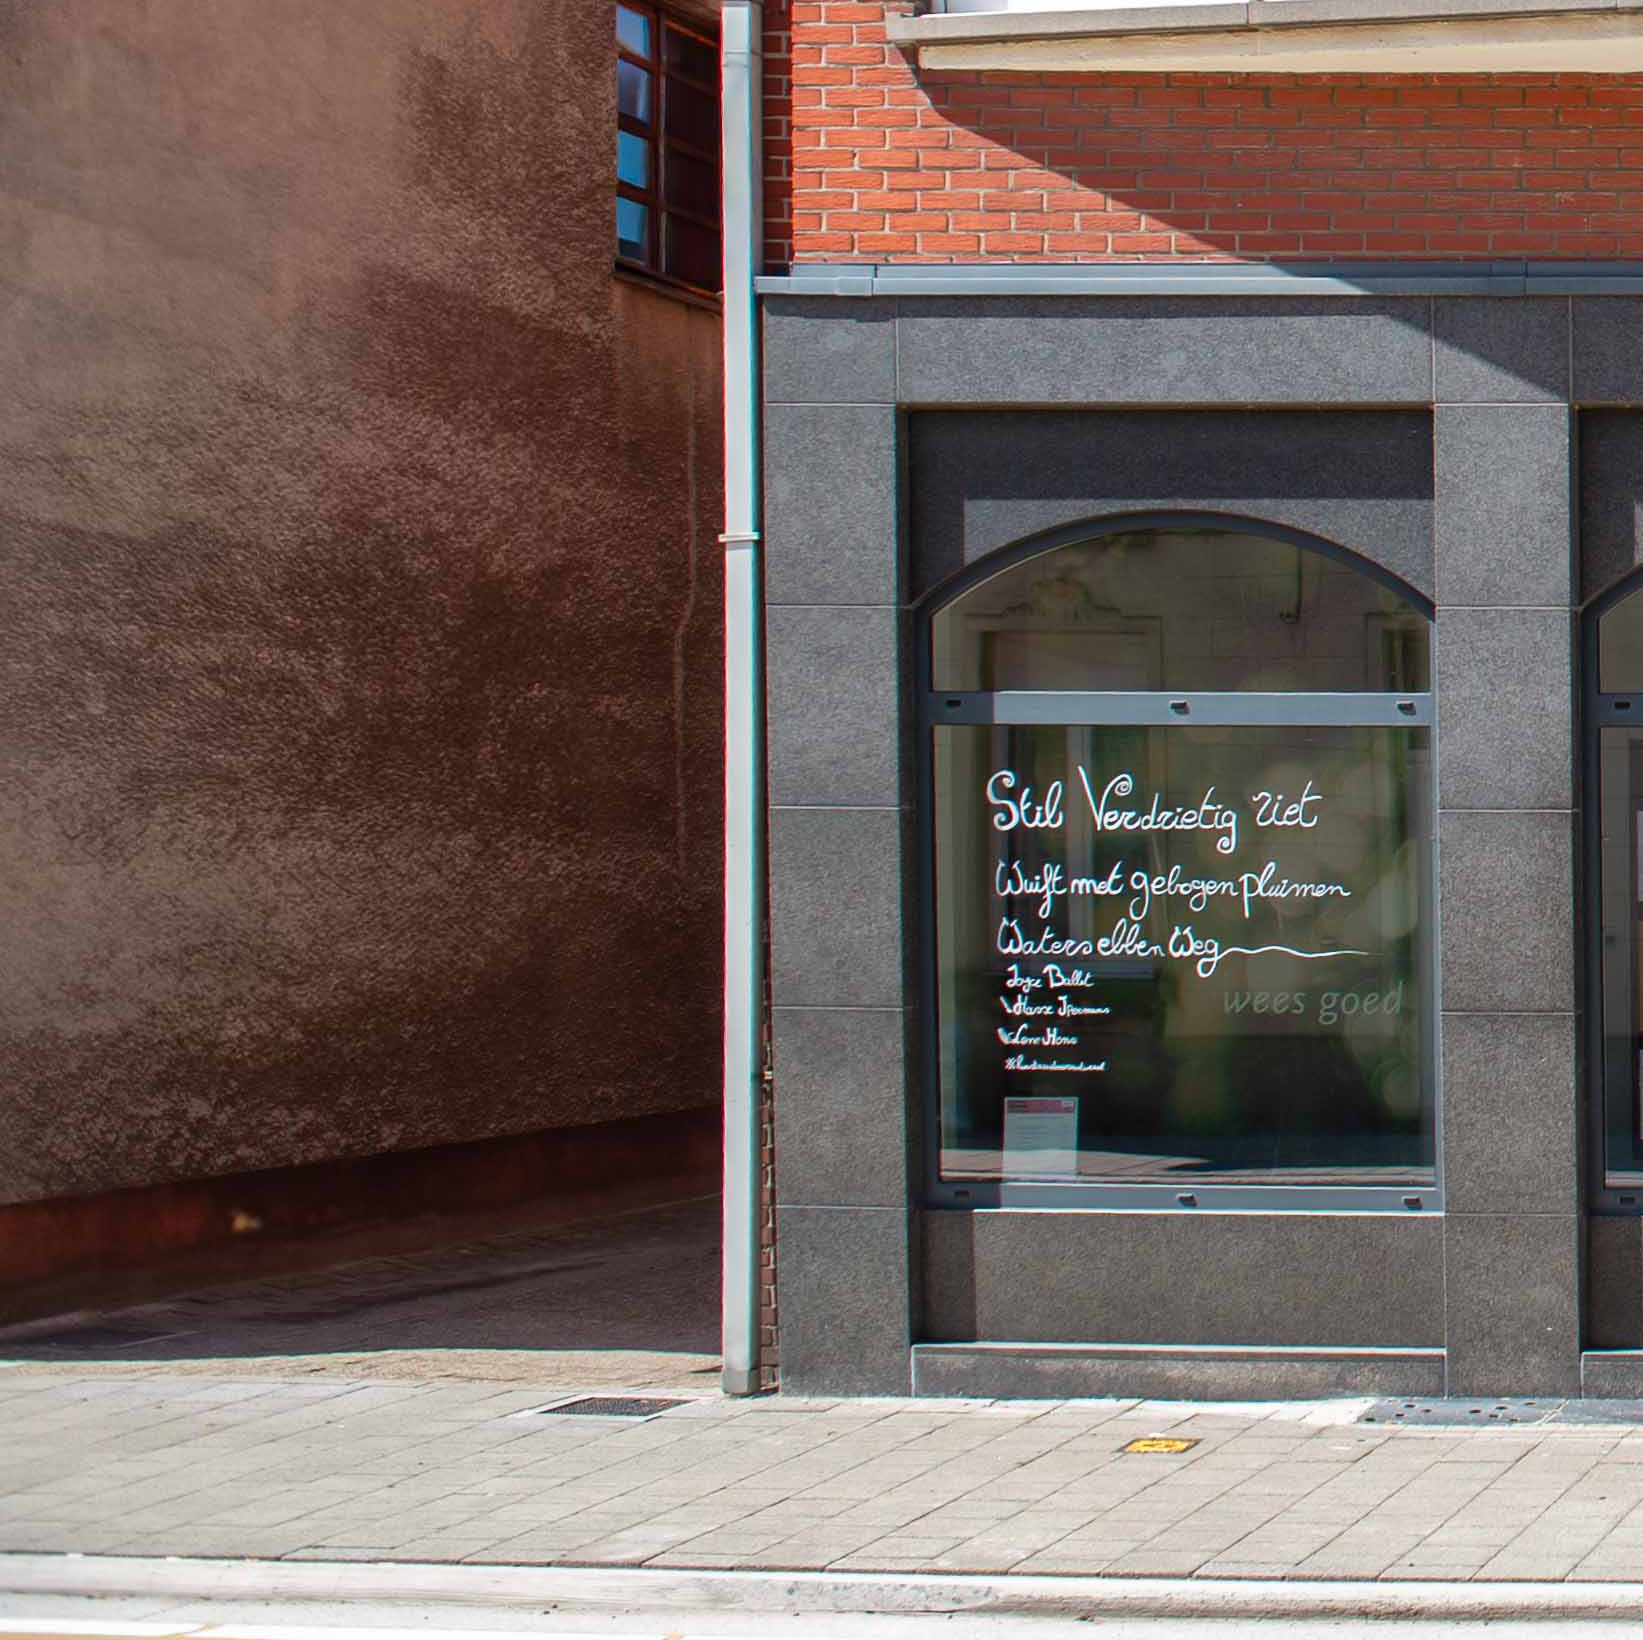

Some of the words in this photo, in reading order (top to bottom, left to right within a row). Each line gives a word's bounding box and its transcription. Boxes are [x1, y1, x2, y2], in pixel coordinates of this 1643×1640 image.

[987, 770, 1064, 831] Stil
[1077, 765, 1238, 854] Verdrietig
[995, 860, 1067, 919] Wuift
[1070, 861, 1124, 895] met
[1129, 864, 1238, 921] gebogen
[1238, 862, 1351, 920] pluimen
[997, 917, 1093, 956] Waters
[1096, 918, 1165, 957] ebben
[1168, 926, 1220, 978] Weg
[1223, 991, 1307, 1015] wees
[1317, 979, 1404, 1026] goed
